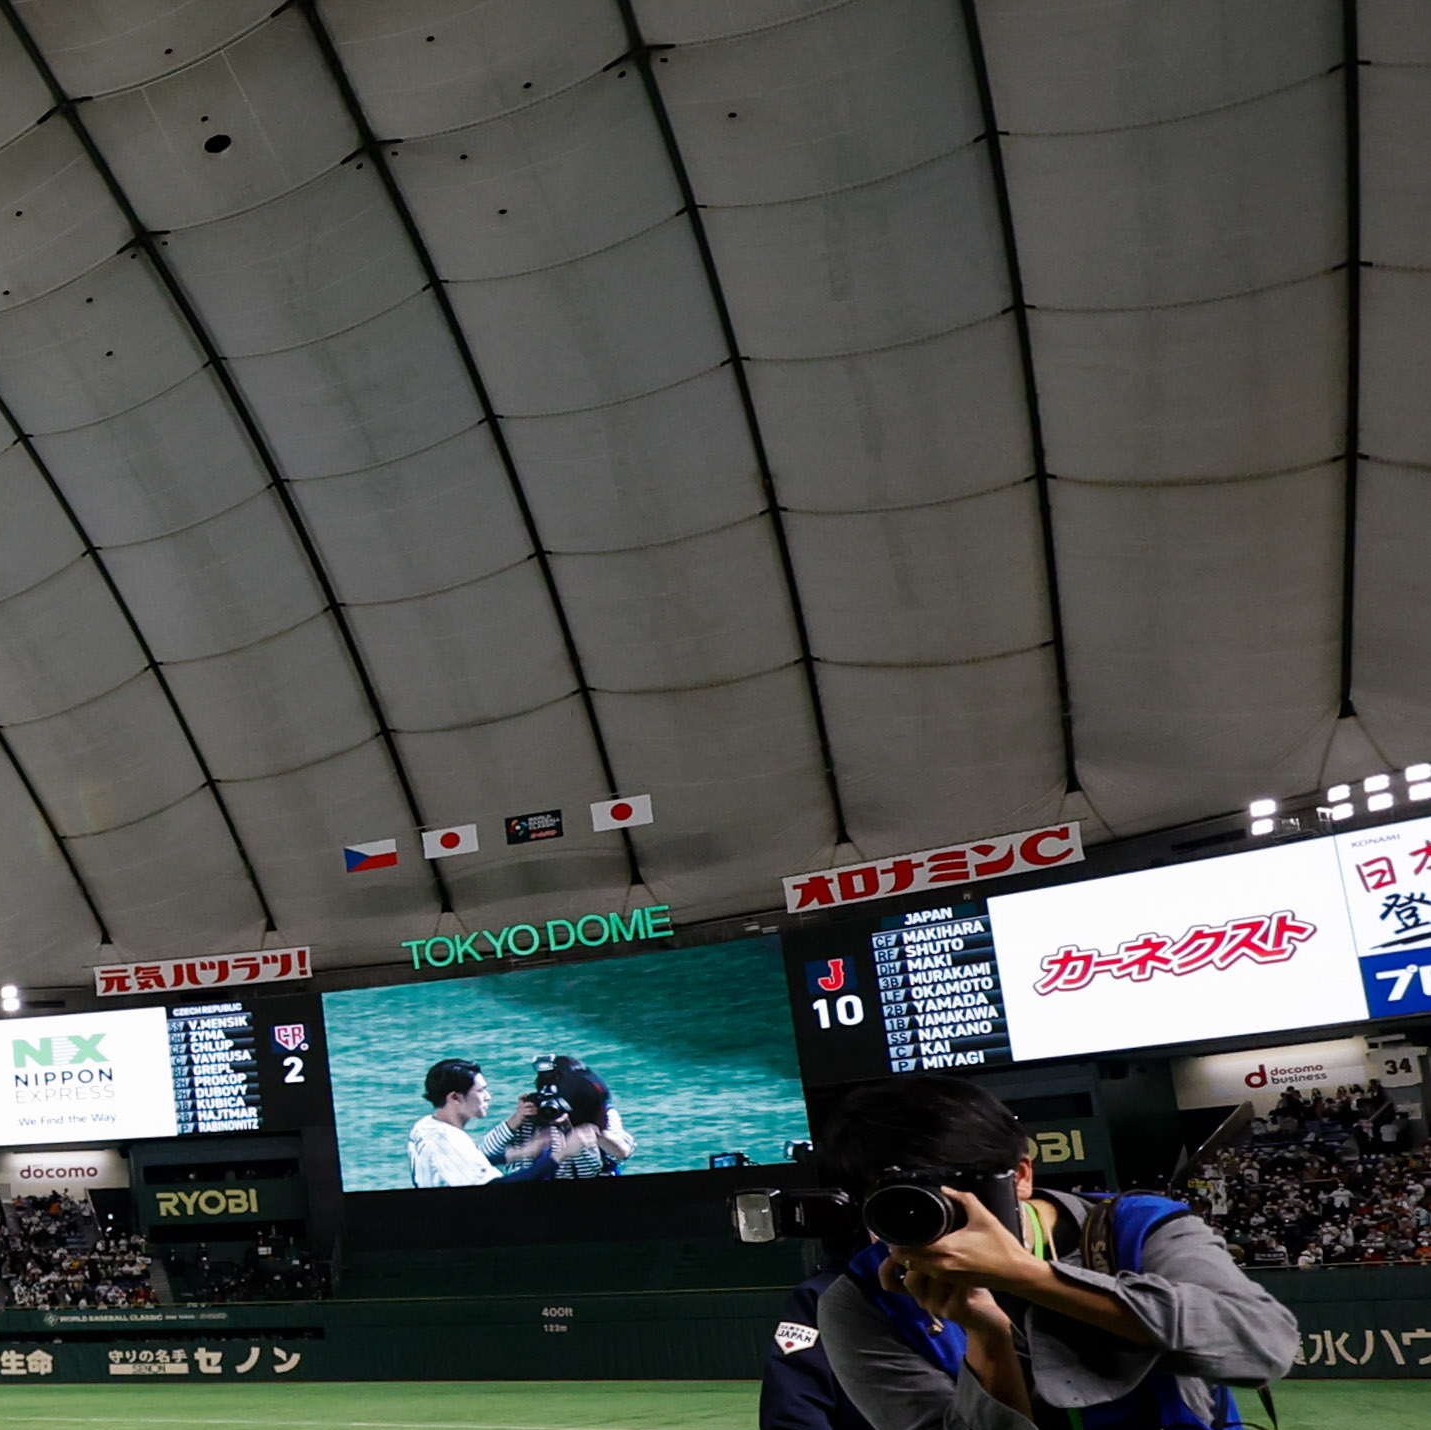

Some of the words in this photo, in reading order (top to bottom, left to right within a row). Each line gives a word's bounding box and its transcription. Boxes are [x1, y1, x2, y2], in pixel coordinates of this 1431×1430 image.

[1351, 833, 1401, 848] KONAMI
[792, 826, 1075, 910] オロナミンC
[903, 906, 953, 926] JAPAN
[401, 924, 540, 970] TOKYO
[546, 904, 675, 951] DOME
[902, 919, 985, 945] MAKIHARA
[905, 937, 964, 958] SHUTO
[1036, 912, 1314, 994] カーネクスト
[906, 953, 953, 972] MAKI
[99, 949, 308, 994] 元気ハツラツ!
[908, 962, 991, 986] MURAKAMI
[911, 977, 994, 1000] OKAMOTO
[172, 1006, 201, 1017] CZECH
[202, 1003, 243, 1015] REPUBLIC
[913, 992, 989, 1014] YAMADA
[812, 995, 864, 1029] 10
[914, 1005, 999, 1028] YAMAKAWA
[188, 1016, 248, 1031] V.MENSIK
[918, 1020, 993, 1042] NAKANO
[189, 1030, 226, 1043] ZYMA
[190, 1040, 234, 1054] CHLUP
[920, 1040, 951, 1056] KAI
[191, 1050, 252, 1065] VAVRUSA
[922, 1050, 985, 1070] MIYAGI
[192, 1062, 235, 1076] GREPL
[282, 1056, 305, 1084] 2
[1271, 1064, 1324, 1076] docomo
[1384, 1058, 1413, 1075] 34
[14, 1067, 113, 1088] NIPPON
[193, 1073, 247, 1088] PROKOP
[1271, 1072, 1328, 1085] business
[16, 1084, 115, 1104] EXPRESS
[195, 1084, 248, 1099] DUBOVY
[196, 1095, 246, 1111] KUBICA
[19, 1117, 37, 1126] We
[40, 1116, 64, 1125] Find
[69, 1114, 87, 1124] the
[91, 1113, 117, 1124] Way
[197, 1107, 258, 1122] HAJTMAR
[198, 1118, 259, 1133] RABINOWITZ
[19, 1164, 99, 1180] docomo
[155, 1188, 259, 1217] RYOBI
[59, 1315, 87, 1323] WORLD
[777, 1329, 813, 1343] JAPAN
[108, 1349, 188, 1364] 守りの名手
[193, 1346, 301, 1374] セノン
